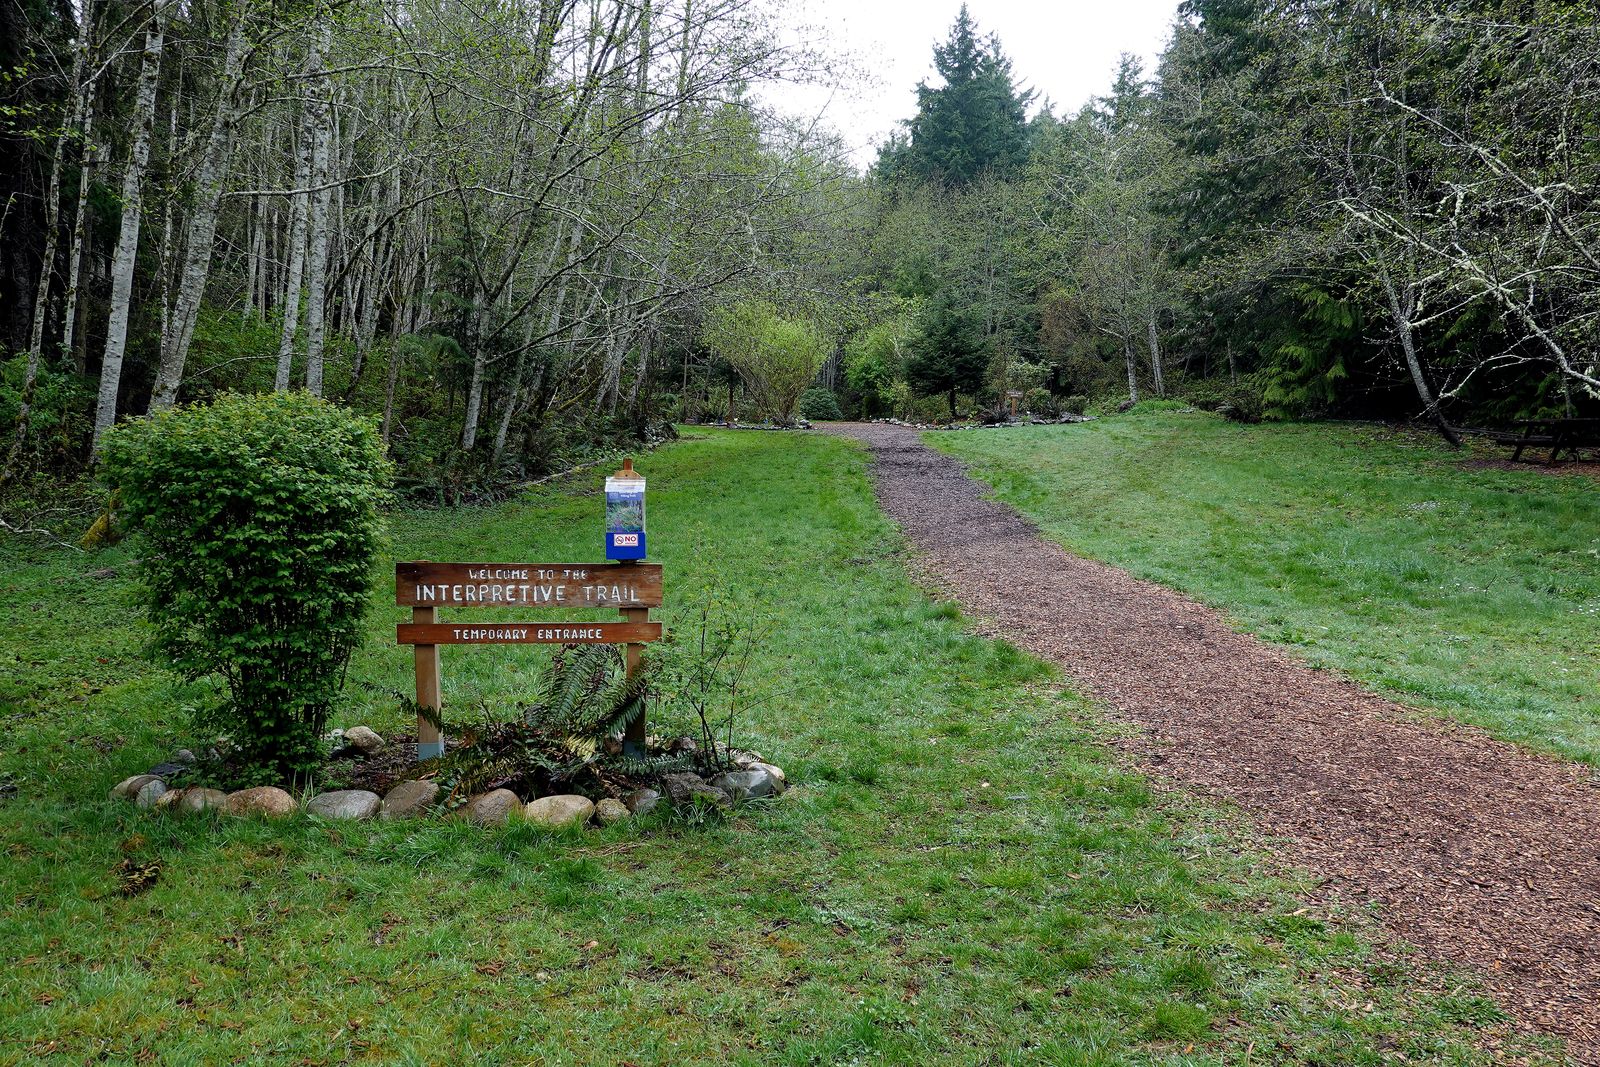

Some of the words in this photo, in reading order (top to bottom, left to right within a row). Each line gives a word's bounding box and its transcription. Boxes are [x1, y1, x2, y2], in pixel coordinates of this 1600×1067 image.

[469, 569, 528, 580] WELCOME
[538, 569, 554, 580] TO
[563, 569, 587, 580] THE
[416, 585, 566, 602] INTERPRETIVE
[583, 585, 640, 602] TRAIL
[453, 629, 528, 639] TEMPORARY
[537, 629, 603, 639] ENTRANCE
